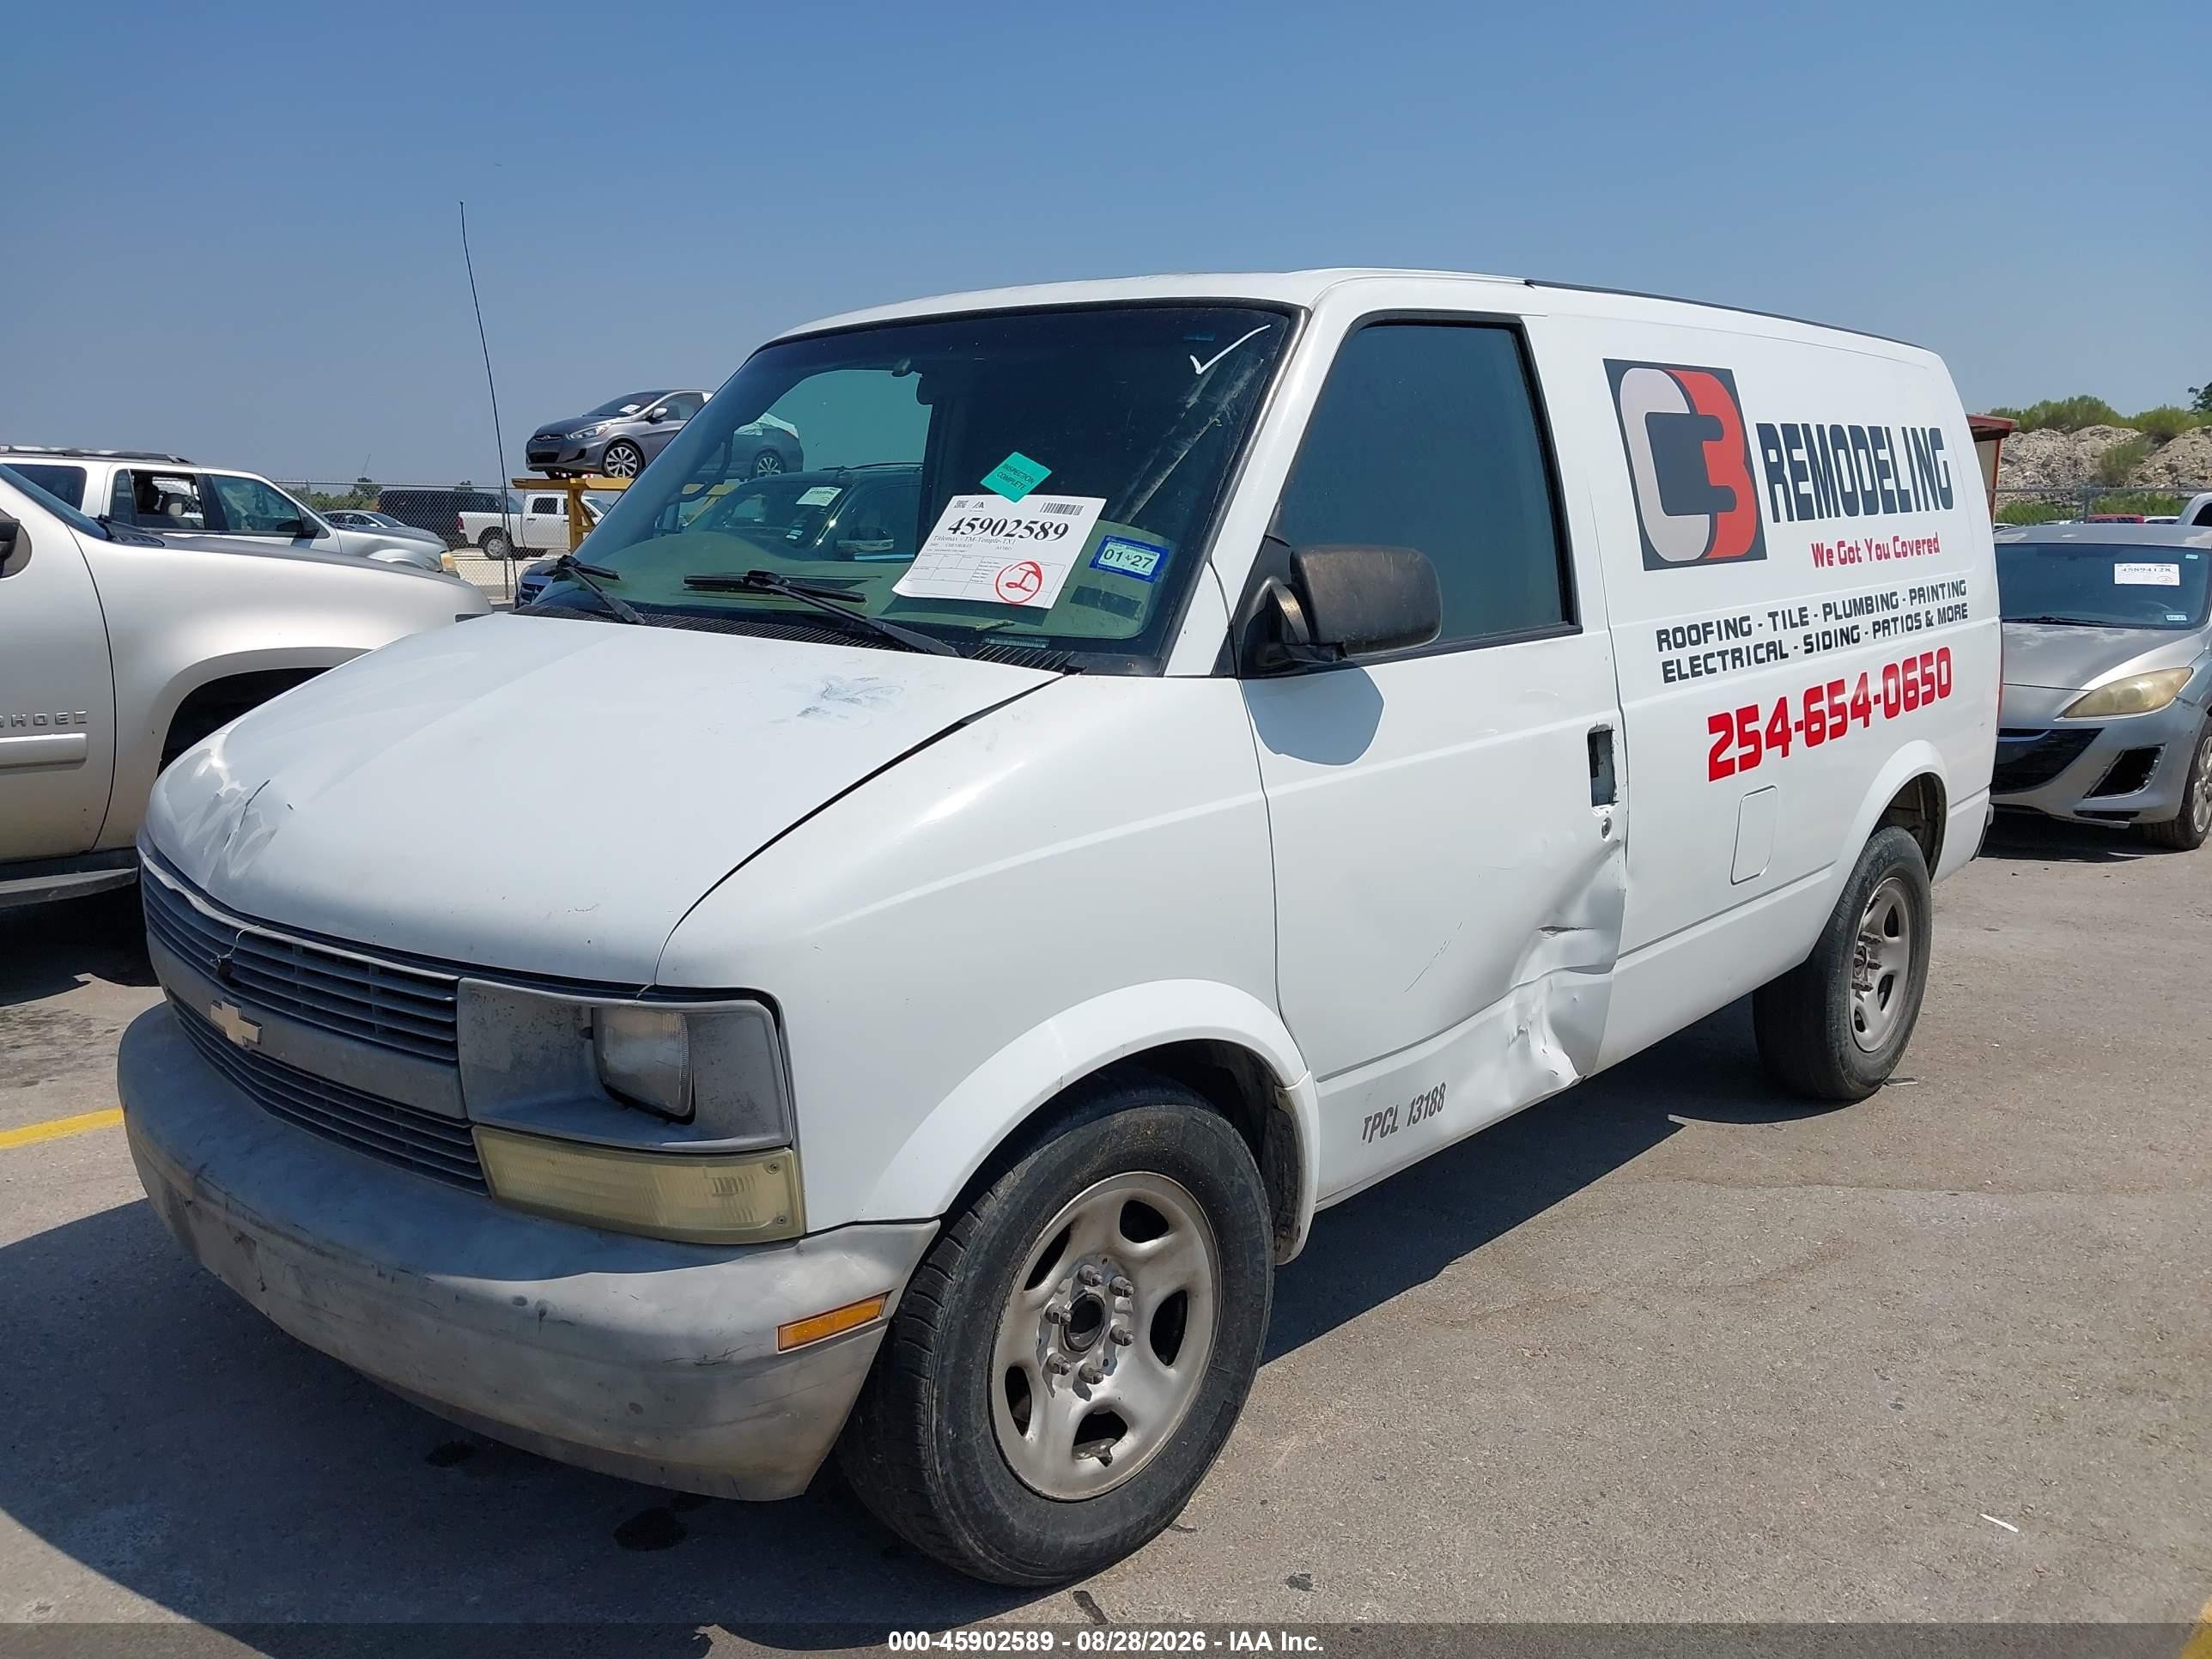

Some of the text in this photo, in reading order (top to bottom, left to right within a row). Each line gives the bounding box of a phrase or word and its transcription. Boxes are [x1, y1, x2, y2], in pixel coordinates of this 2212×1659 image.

[997, 471, 1027, 490] COMPLETE
[1003, 463, 1036, 483] INSPECTION
[1755, 422, 1954, 524] REMODELING
[948, 516, 1069, 542] 45902589
[1811, 532, 1940, 568] We Got You Covered
[1656, 615, 1753, 653] ROOFING
[1767, 606, 1810, 632] TILE
[1822, 591, 1899, 623] PLUMBING
[1909, 580, 1967, 606] PAINTING
[1662, 639, 1790, 684] ELECTRICAL
[1802, 624, 1861, 654] SIDING
[1872, 612, 1923, 639] PATIOS
[1924, 610, 1934, 628] &
[1937, 603, 1969, 625] MORE
[1707, 646, 1953, 782] 254-654-0650
[1362, 1082, 1447, 1144] TPCL 13188
